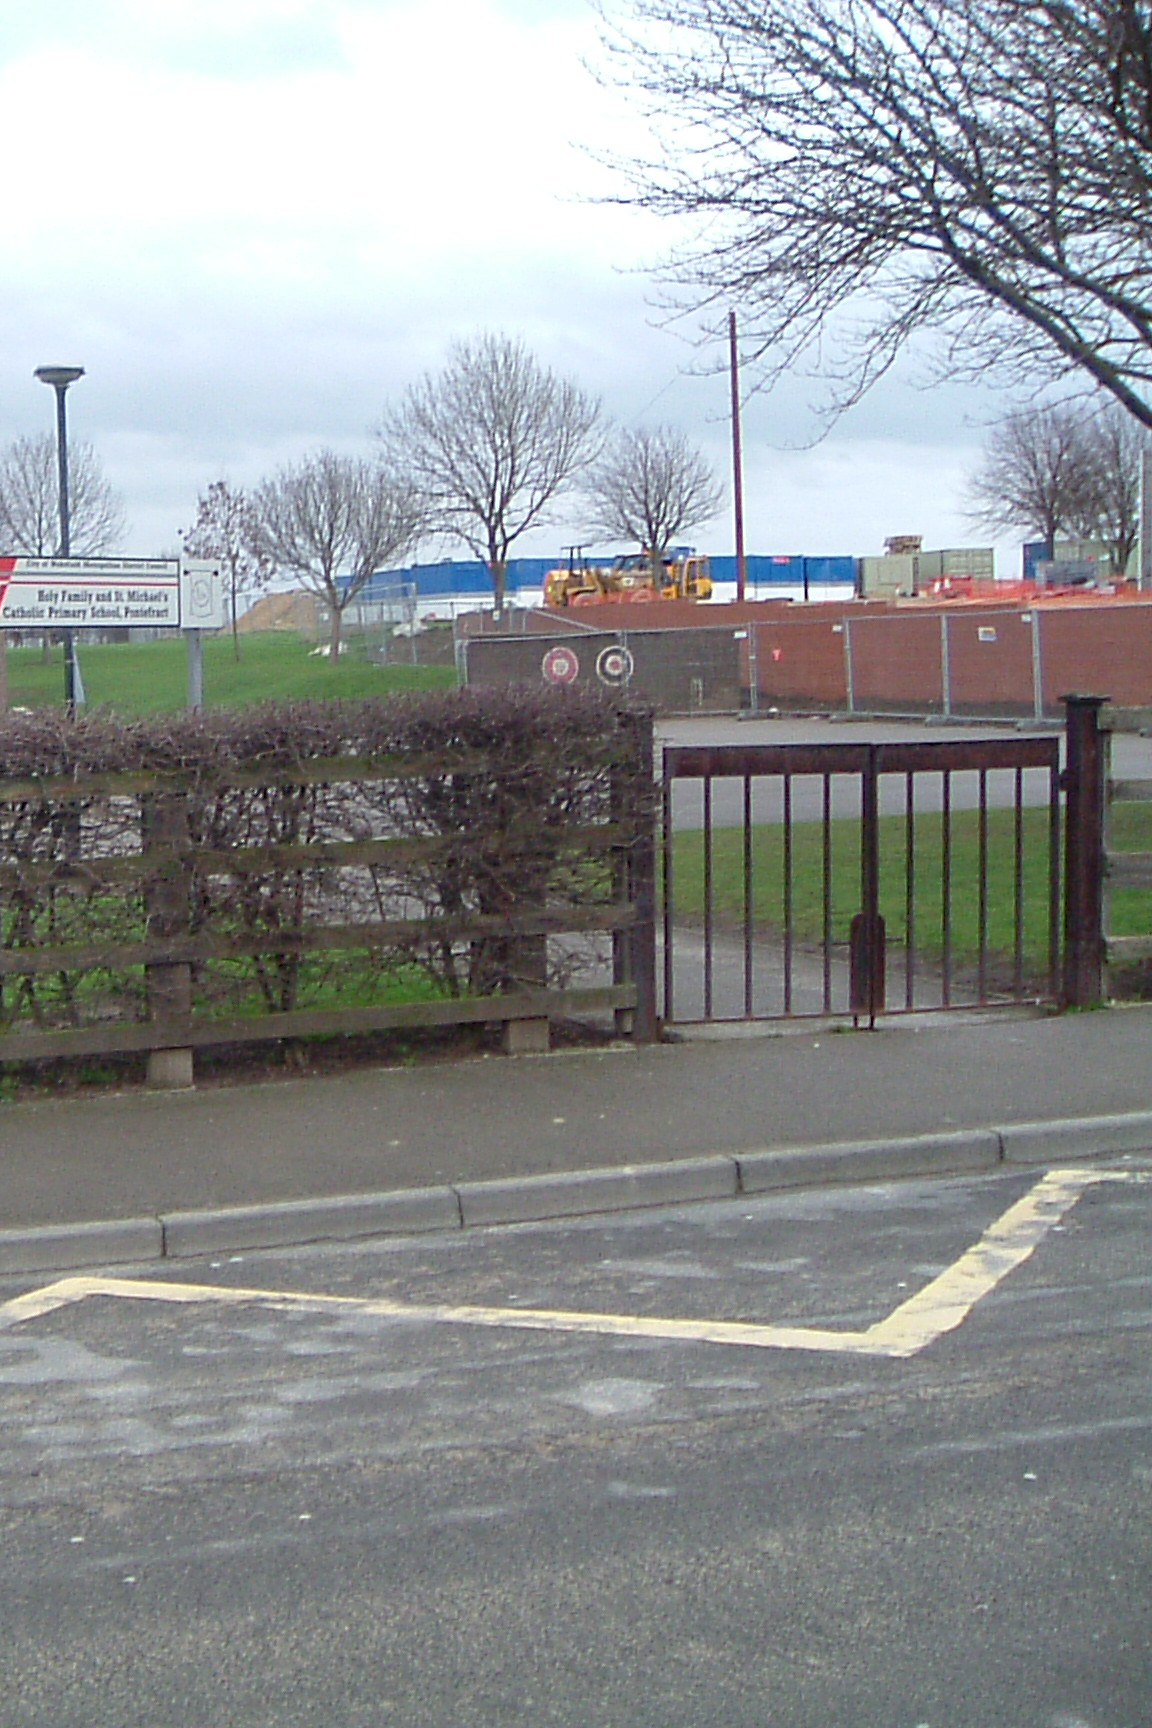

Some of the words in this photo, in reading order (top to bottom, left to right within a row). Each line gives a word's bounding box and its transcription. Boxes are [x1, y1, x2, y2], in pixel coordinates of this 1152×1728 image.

[38, 589, 59, 604] Holy
[61, 589, 93, 604] Family
[96, 590, 113, 602] and
[127, 590, 168, 602] Michael's
[2, 606, 44, 618] Catholic
[48, 606, 88, 620] Primary
[124, 607, 168, 618] Pontefract
